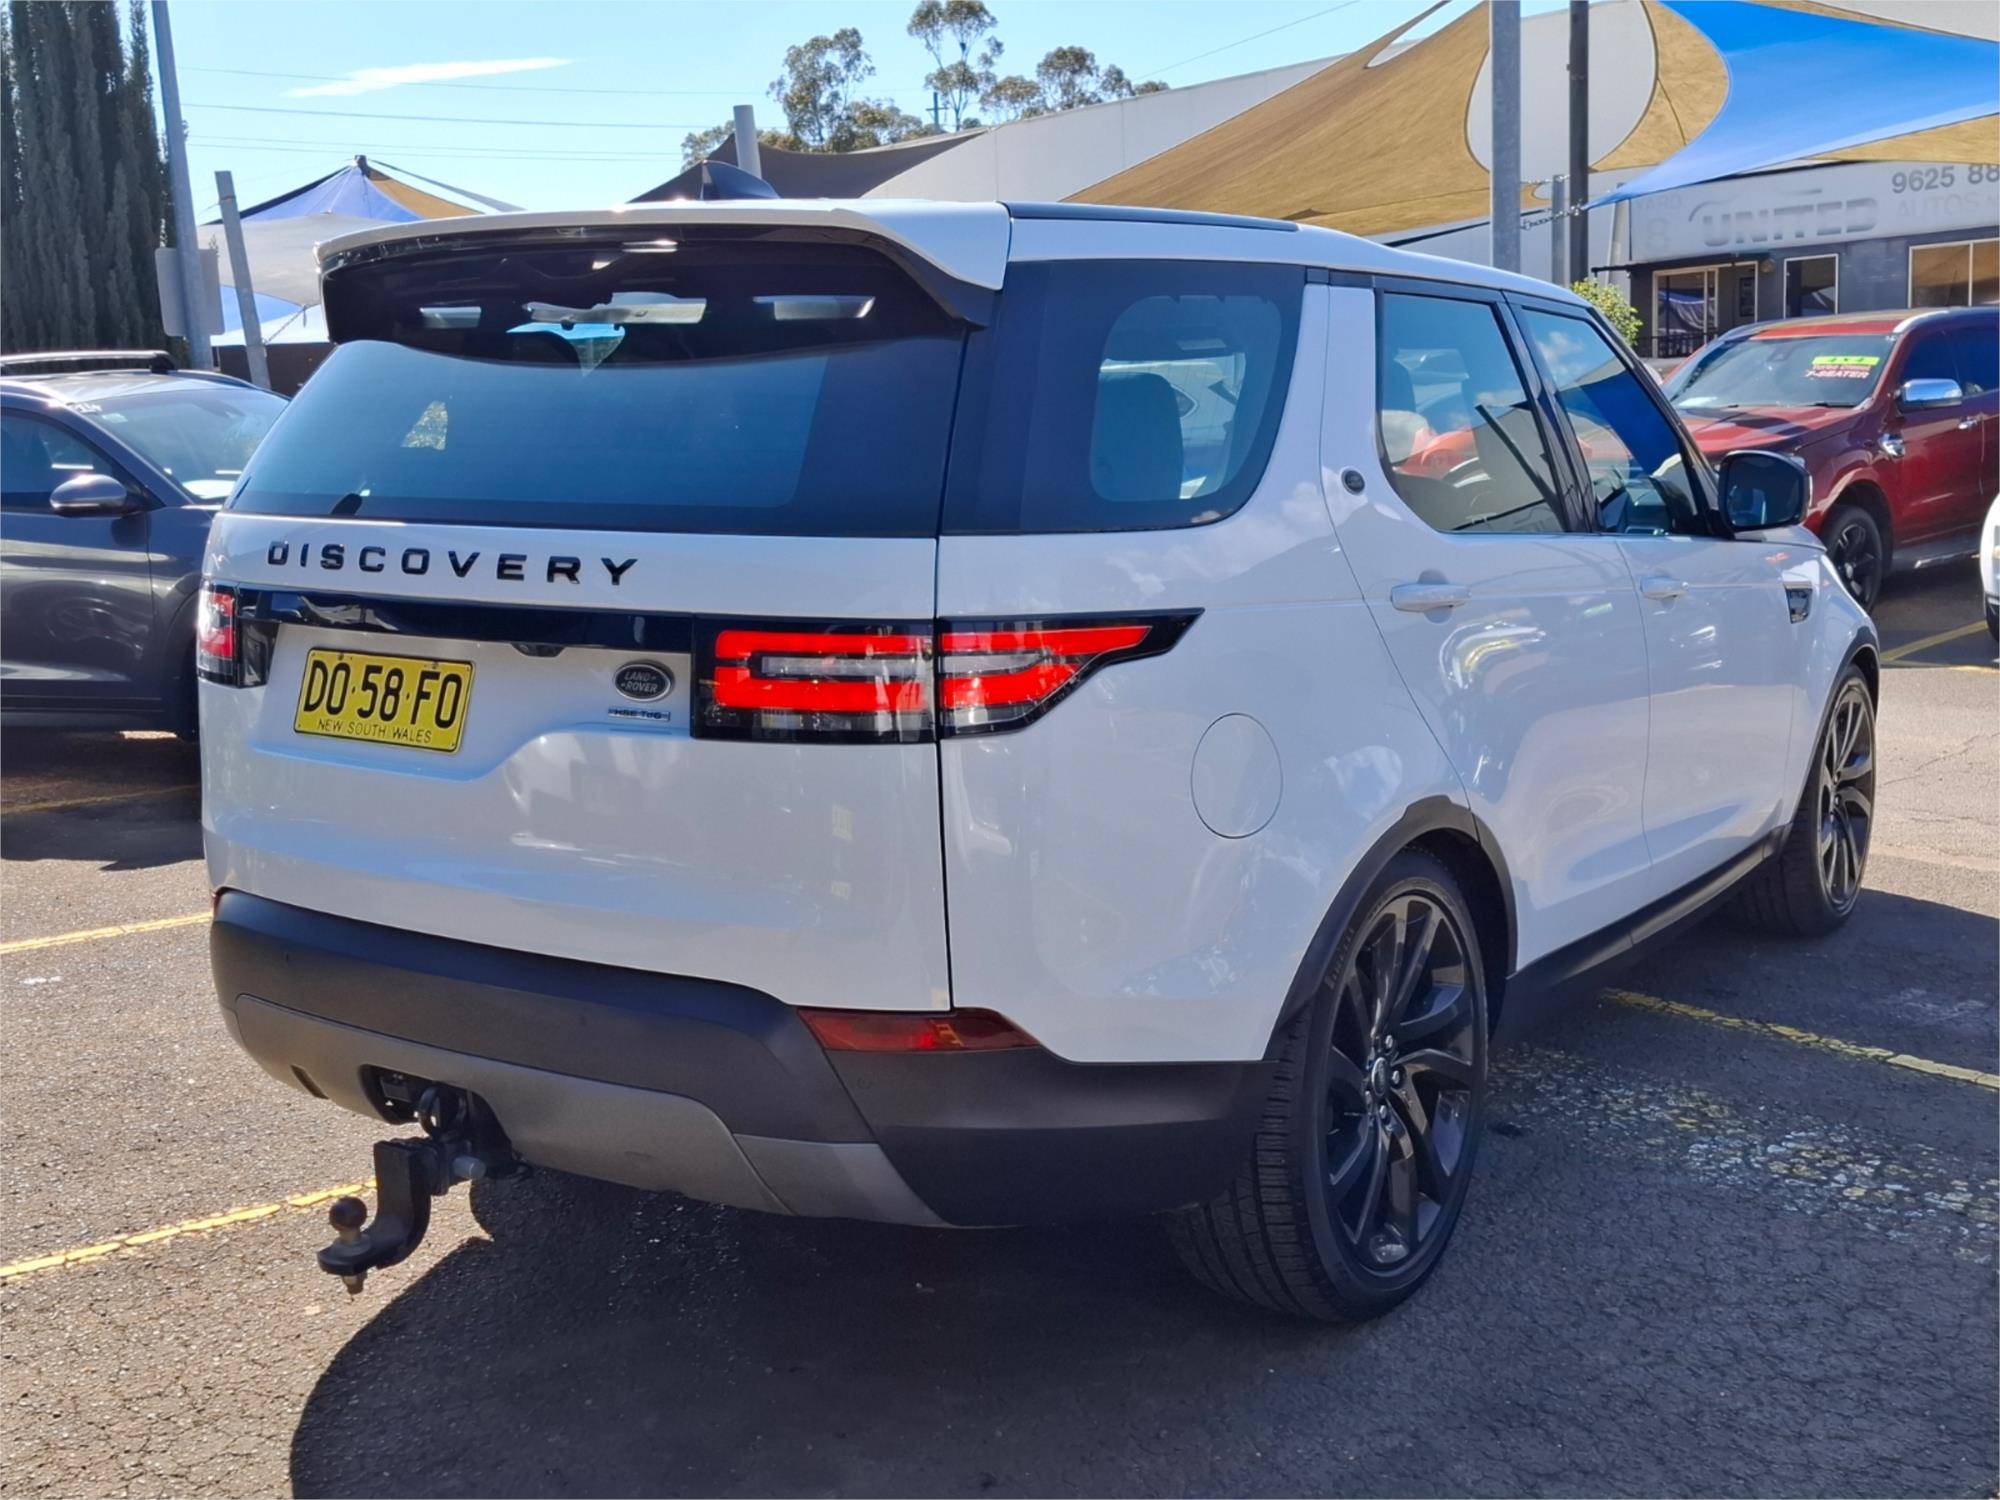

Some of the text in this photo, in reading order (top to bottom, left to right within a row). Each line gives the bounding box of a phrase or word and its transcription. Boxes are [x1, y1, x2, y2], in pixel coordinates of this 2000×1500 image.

[1891, 165, 1956, 194] 9625
[1702, 197, 1879, 248] UNITED
[266, 540, 638, 586] DISCOVERY
[624, 671, 651, 681] LAND
[625, 681, 658, 692] ROVER
[317, 718, 432, 744] NEW SOUTH WALES
